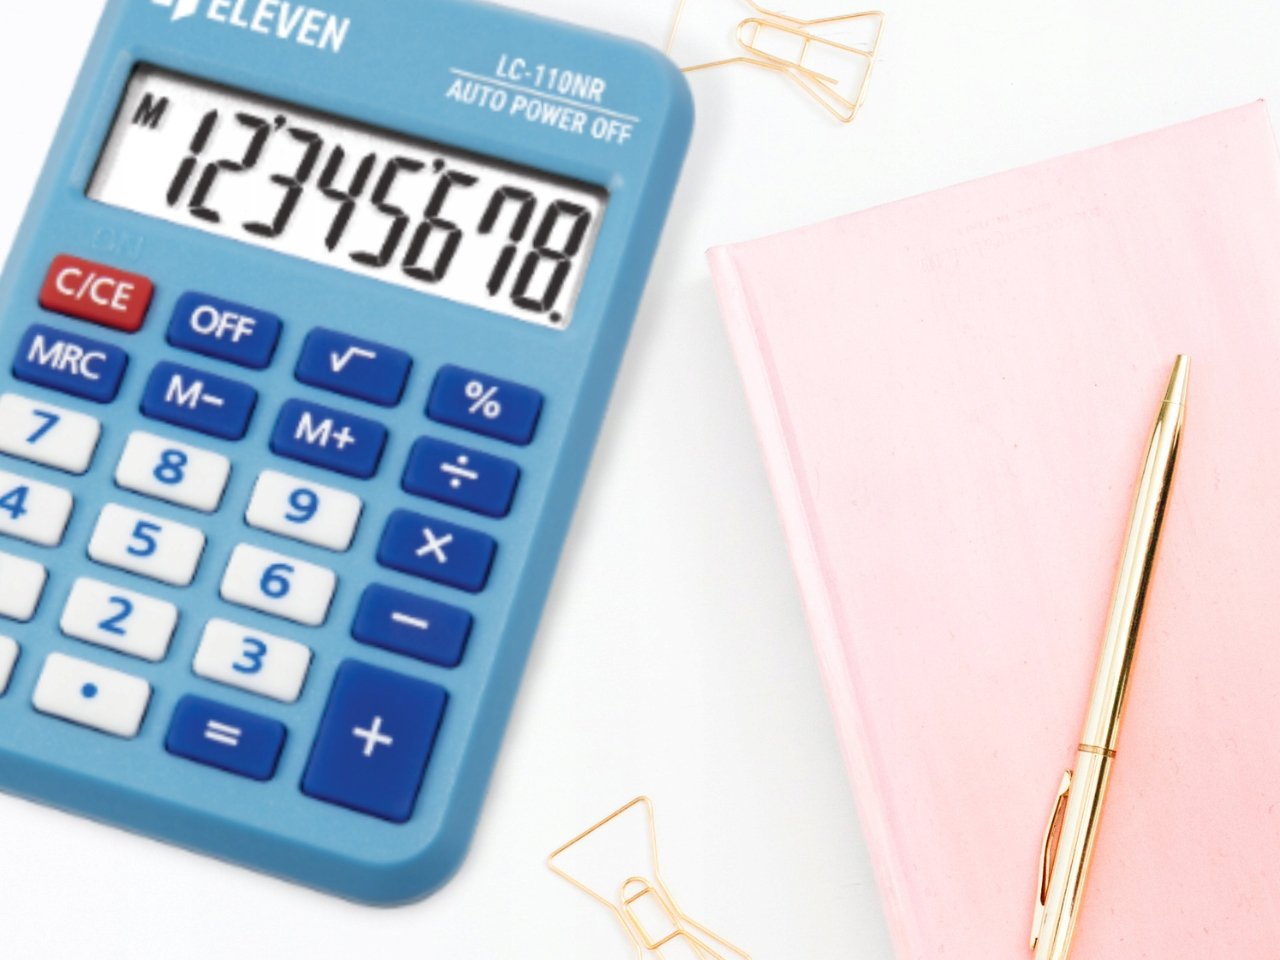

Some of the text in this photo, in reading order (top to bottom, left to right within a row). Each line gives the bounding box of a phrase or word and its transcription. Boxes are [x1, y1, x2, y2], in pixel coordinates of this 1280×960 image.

[494, 53, 607, 104] LC-110NR
[133, 93, 168, 128] M
[444, 77, 634, 145] AUTO POWER OFF
[54, 266, 136, 314] C/CE
[190, 305, 256, 342] OFF
[26, 334, 107, 381] MRC
[465, 380, 502, 419] %
[28, 408, 61, 445] 7
[294, 412, 356, 449] M+
[152, 448, 189, 486] 8
[0, 485, 29, 520] 4
[285, 488, 319, 524] 9
[126, 519, 162, 558] 5
[259, 563, 294, 599] 6
[98, 596, 133, 635] 2
[232, 637, 267, 674] 3
